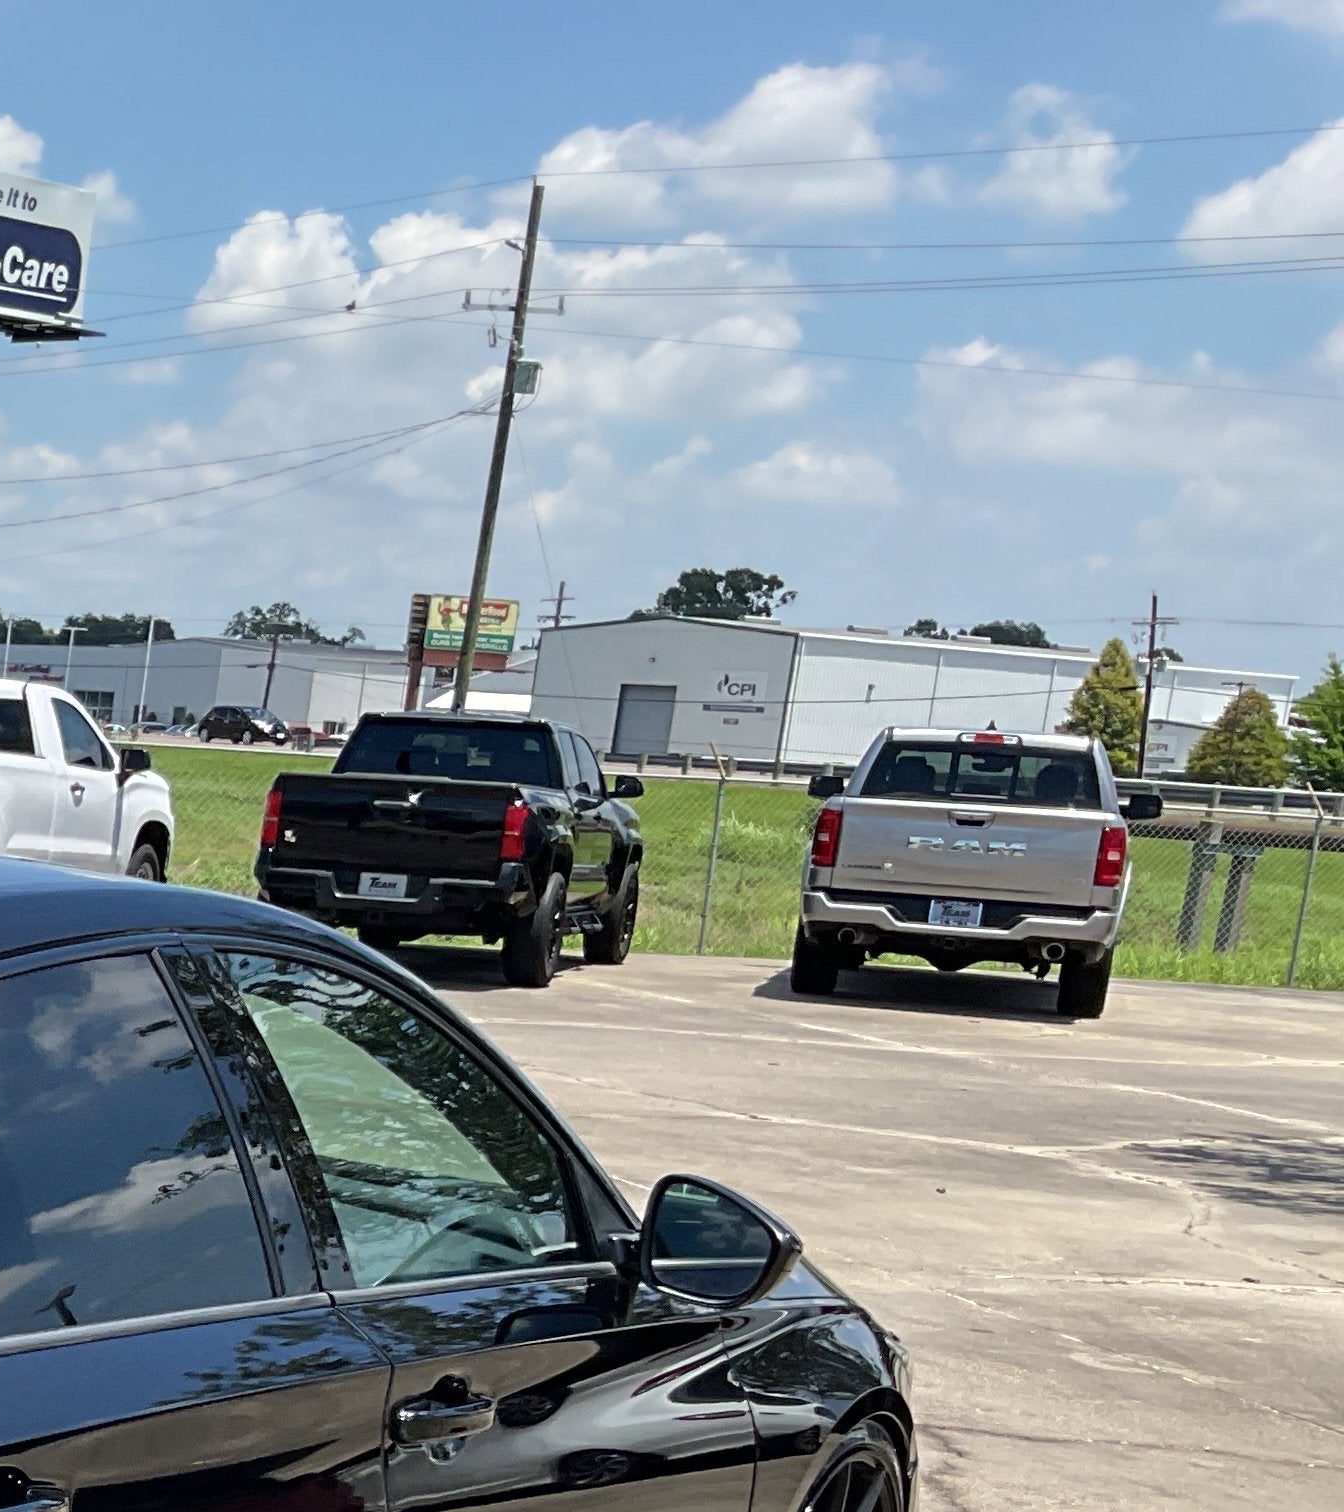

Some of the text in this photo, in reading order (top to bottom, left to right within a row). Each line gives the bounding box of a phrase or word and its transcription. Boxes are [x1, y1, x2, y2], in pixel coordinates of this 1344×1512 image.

[22, 192, 38, 212] to
[727, 683, 756, 696] CPI
[907, 836, 1027, 857] RAM
